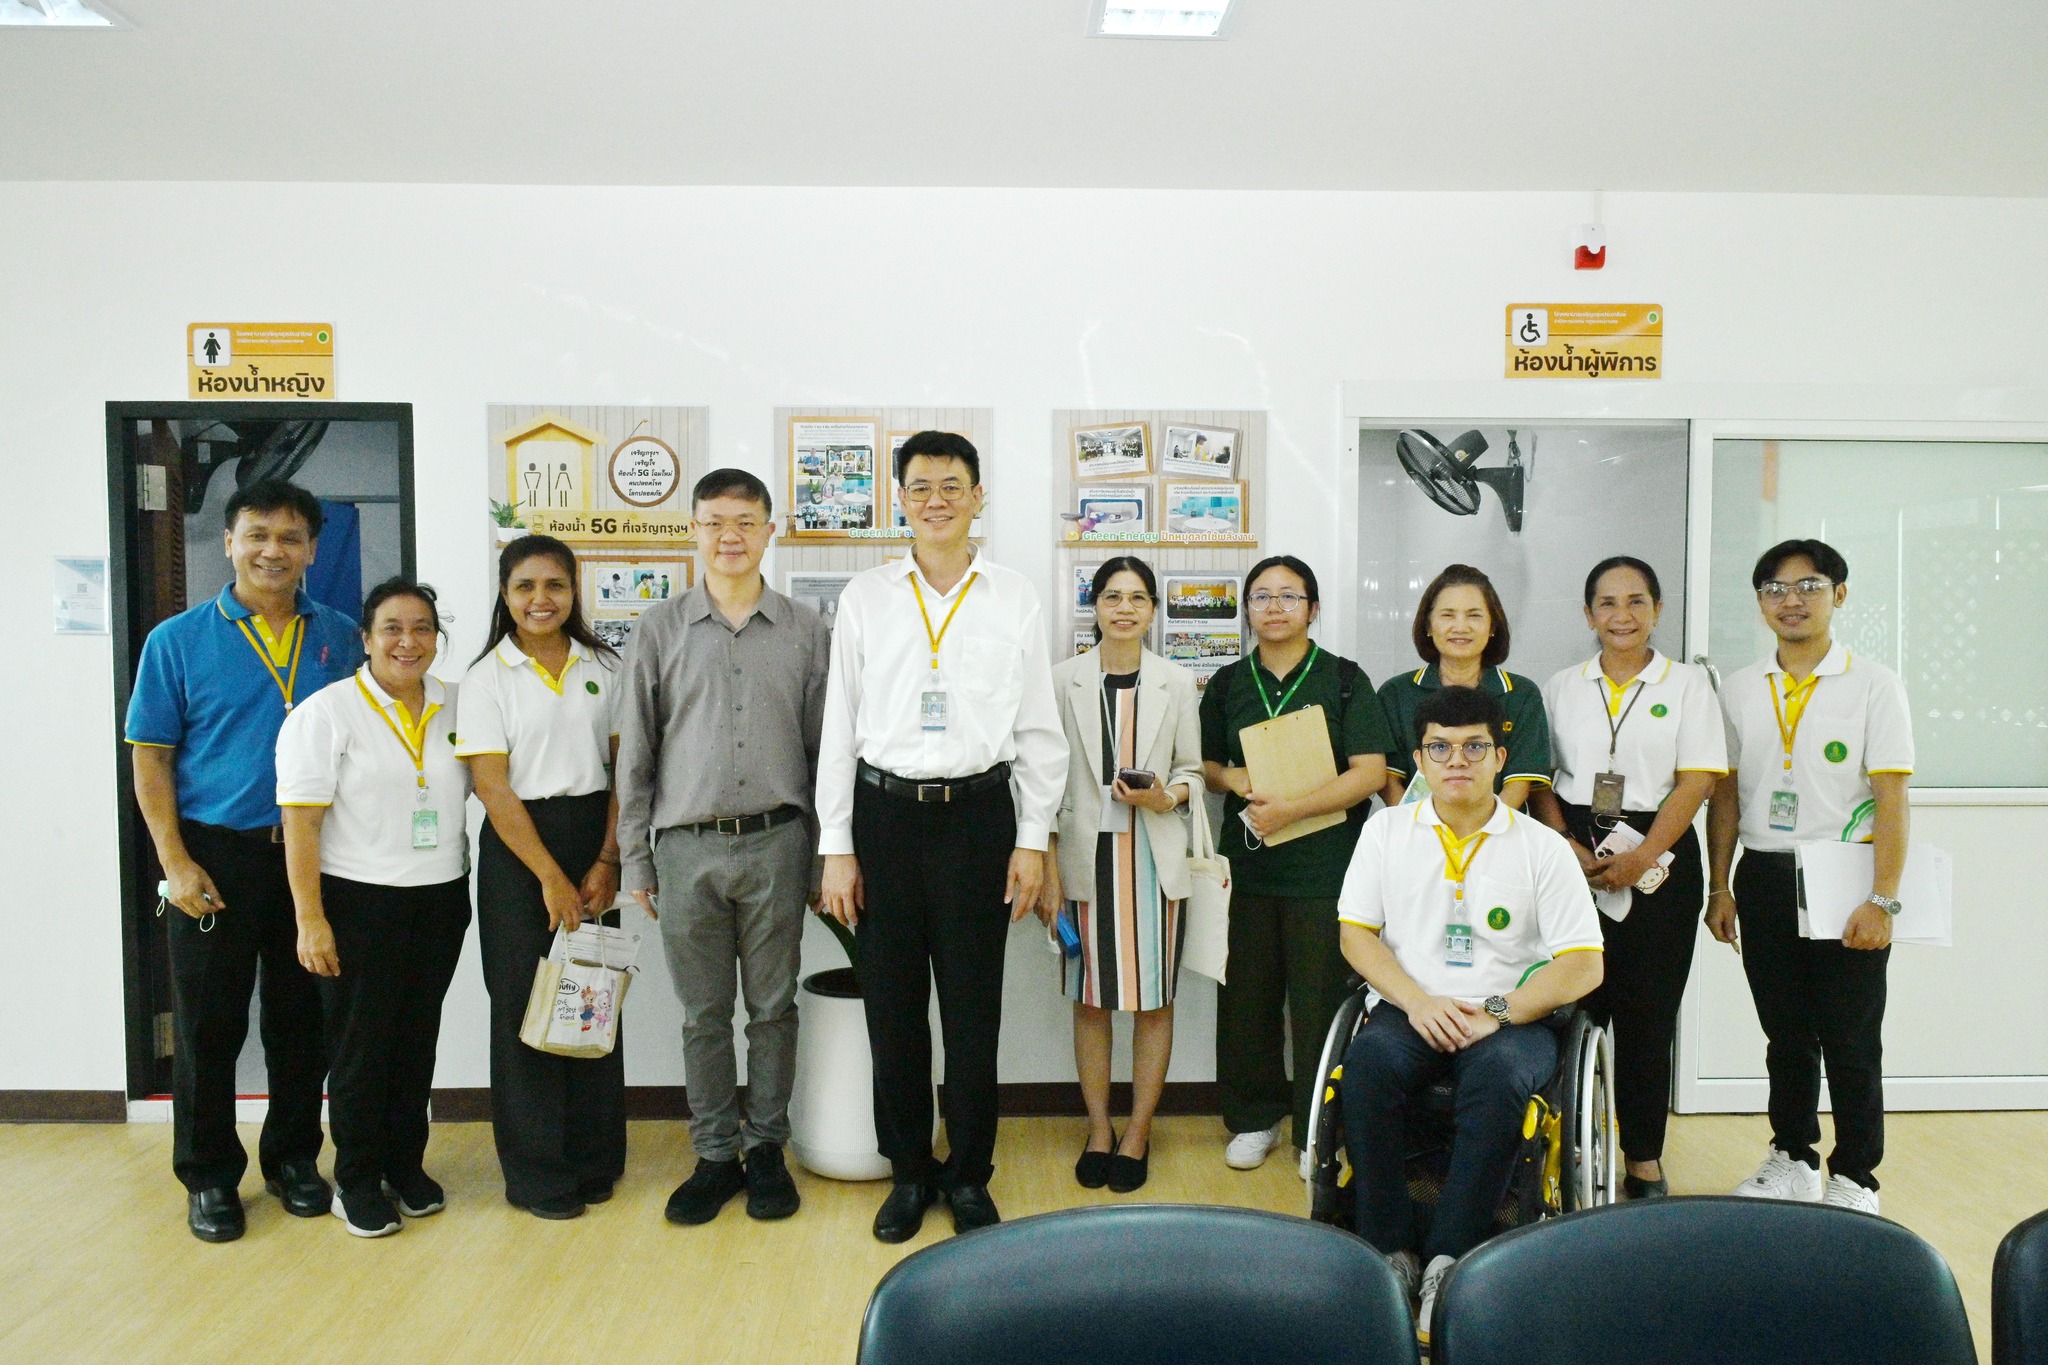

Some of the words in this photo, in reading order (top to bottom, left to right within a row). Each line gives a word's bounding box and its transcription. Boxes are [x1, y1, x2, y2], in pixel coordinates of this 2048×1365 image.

[1514, 343, 1657, 378] ห้องน้ำผู้พิการ
[198, 364, 325, 398] ห้องน้ำหญิง
[617, 468, 637, 477] ห้องน้ำ
[637, 469, 649, 477] 5G
[549, 517, 586, 532] ห้องน้ำ
[590, 518, 617, 534] 5G
[622, 519, 688, 537] ที่เจริญกรุงฯ
[848, 528, 883, 538] Green
[885, 528, 902, 538] Air
[1083, 531, 1118, 542] Green
[1119, 531, 1159, 544] Energy
